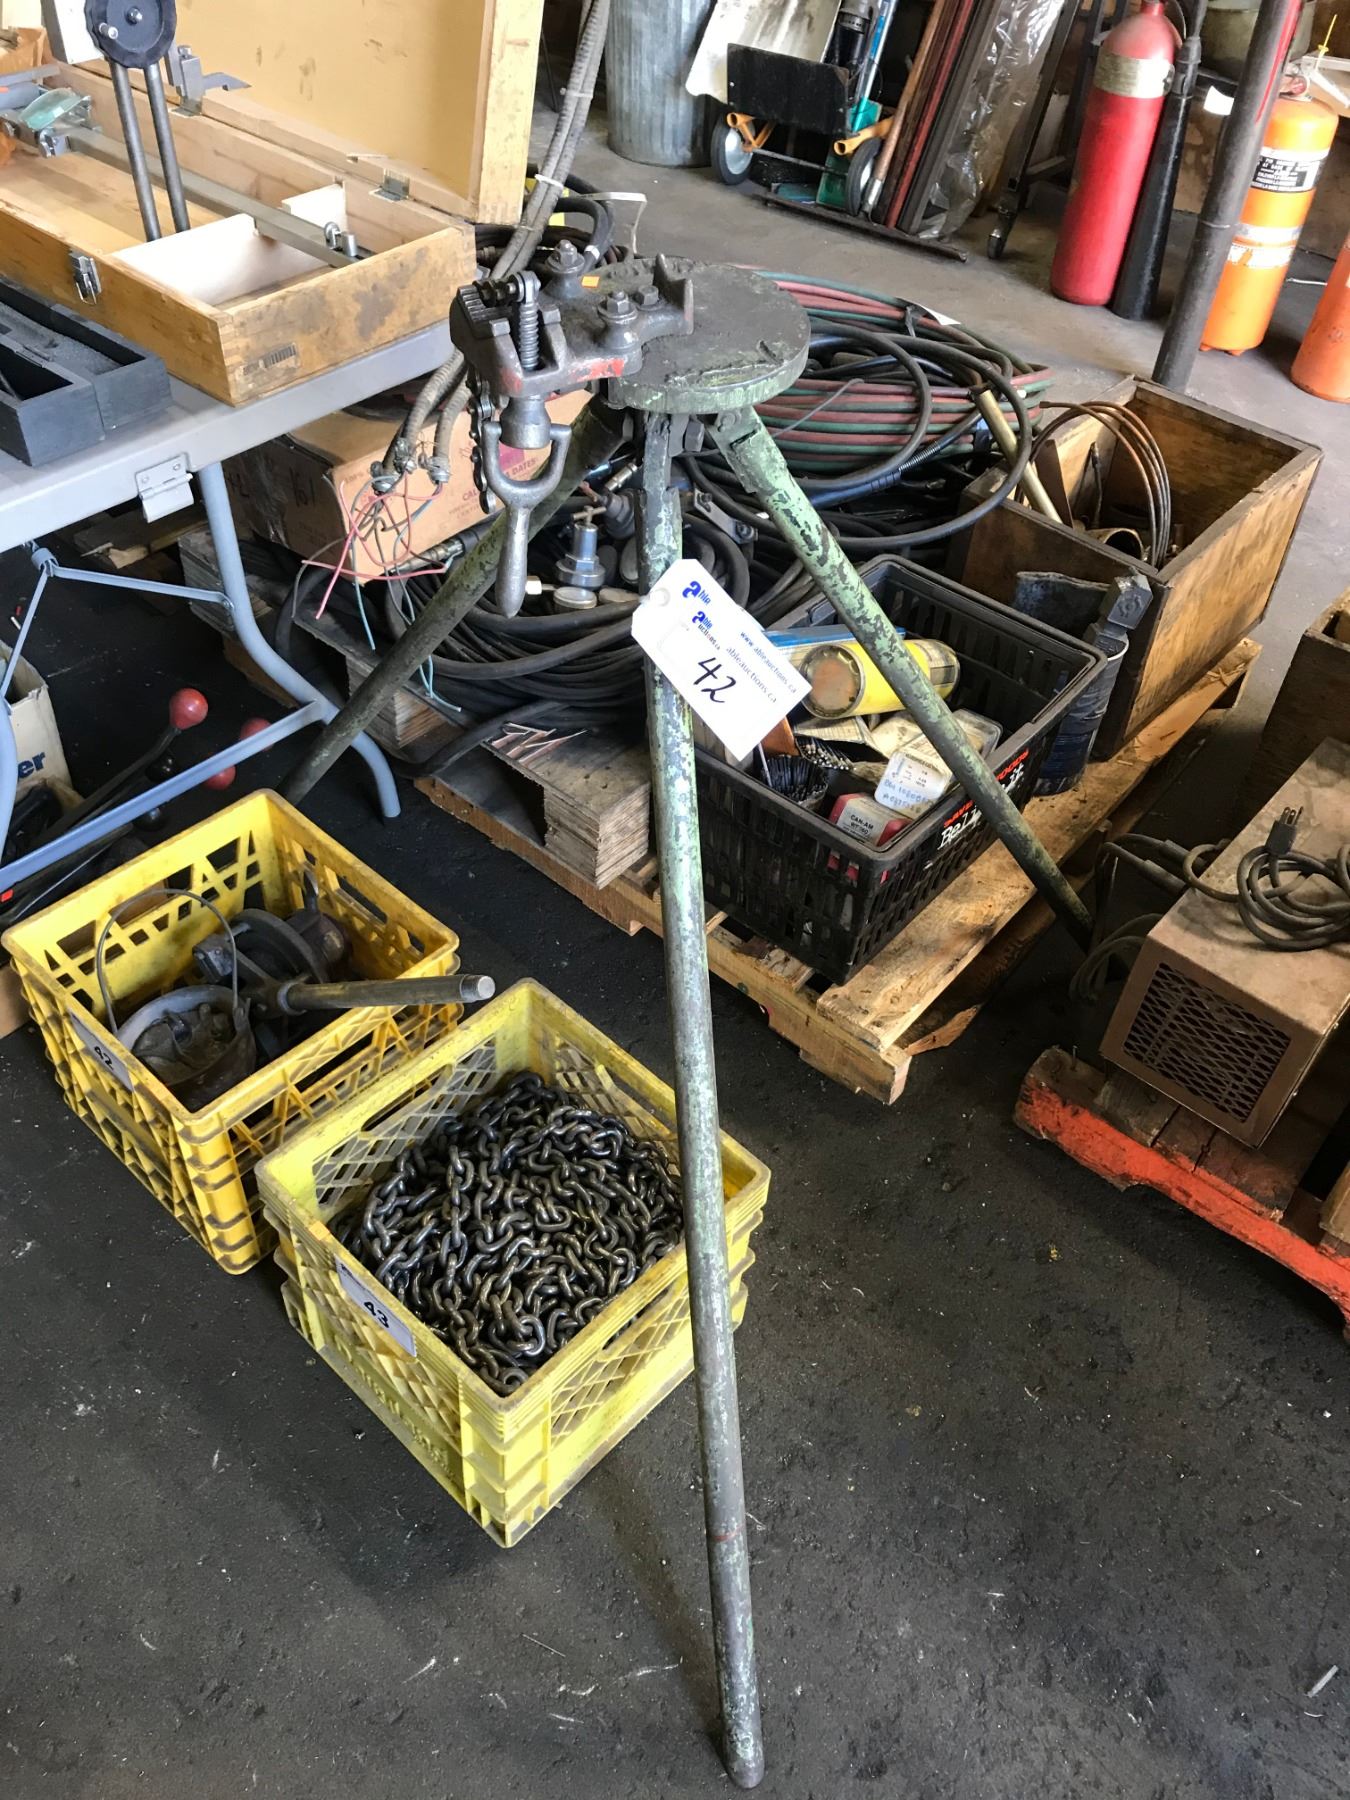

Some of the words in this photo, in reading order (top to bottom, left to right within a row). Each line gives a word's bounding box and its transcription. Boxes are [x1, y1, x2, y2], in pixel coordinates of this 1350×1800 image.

[693, 656, 737, 704] 42
[850, 814, 874, 830] CAN-AM
[93, 1045, 115, 1071] 42
[363, 1301, 390, 1329] 43
